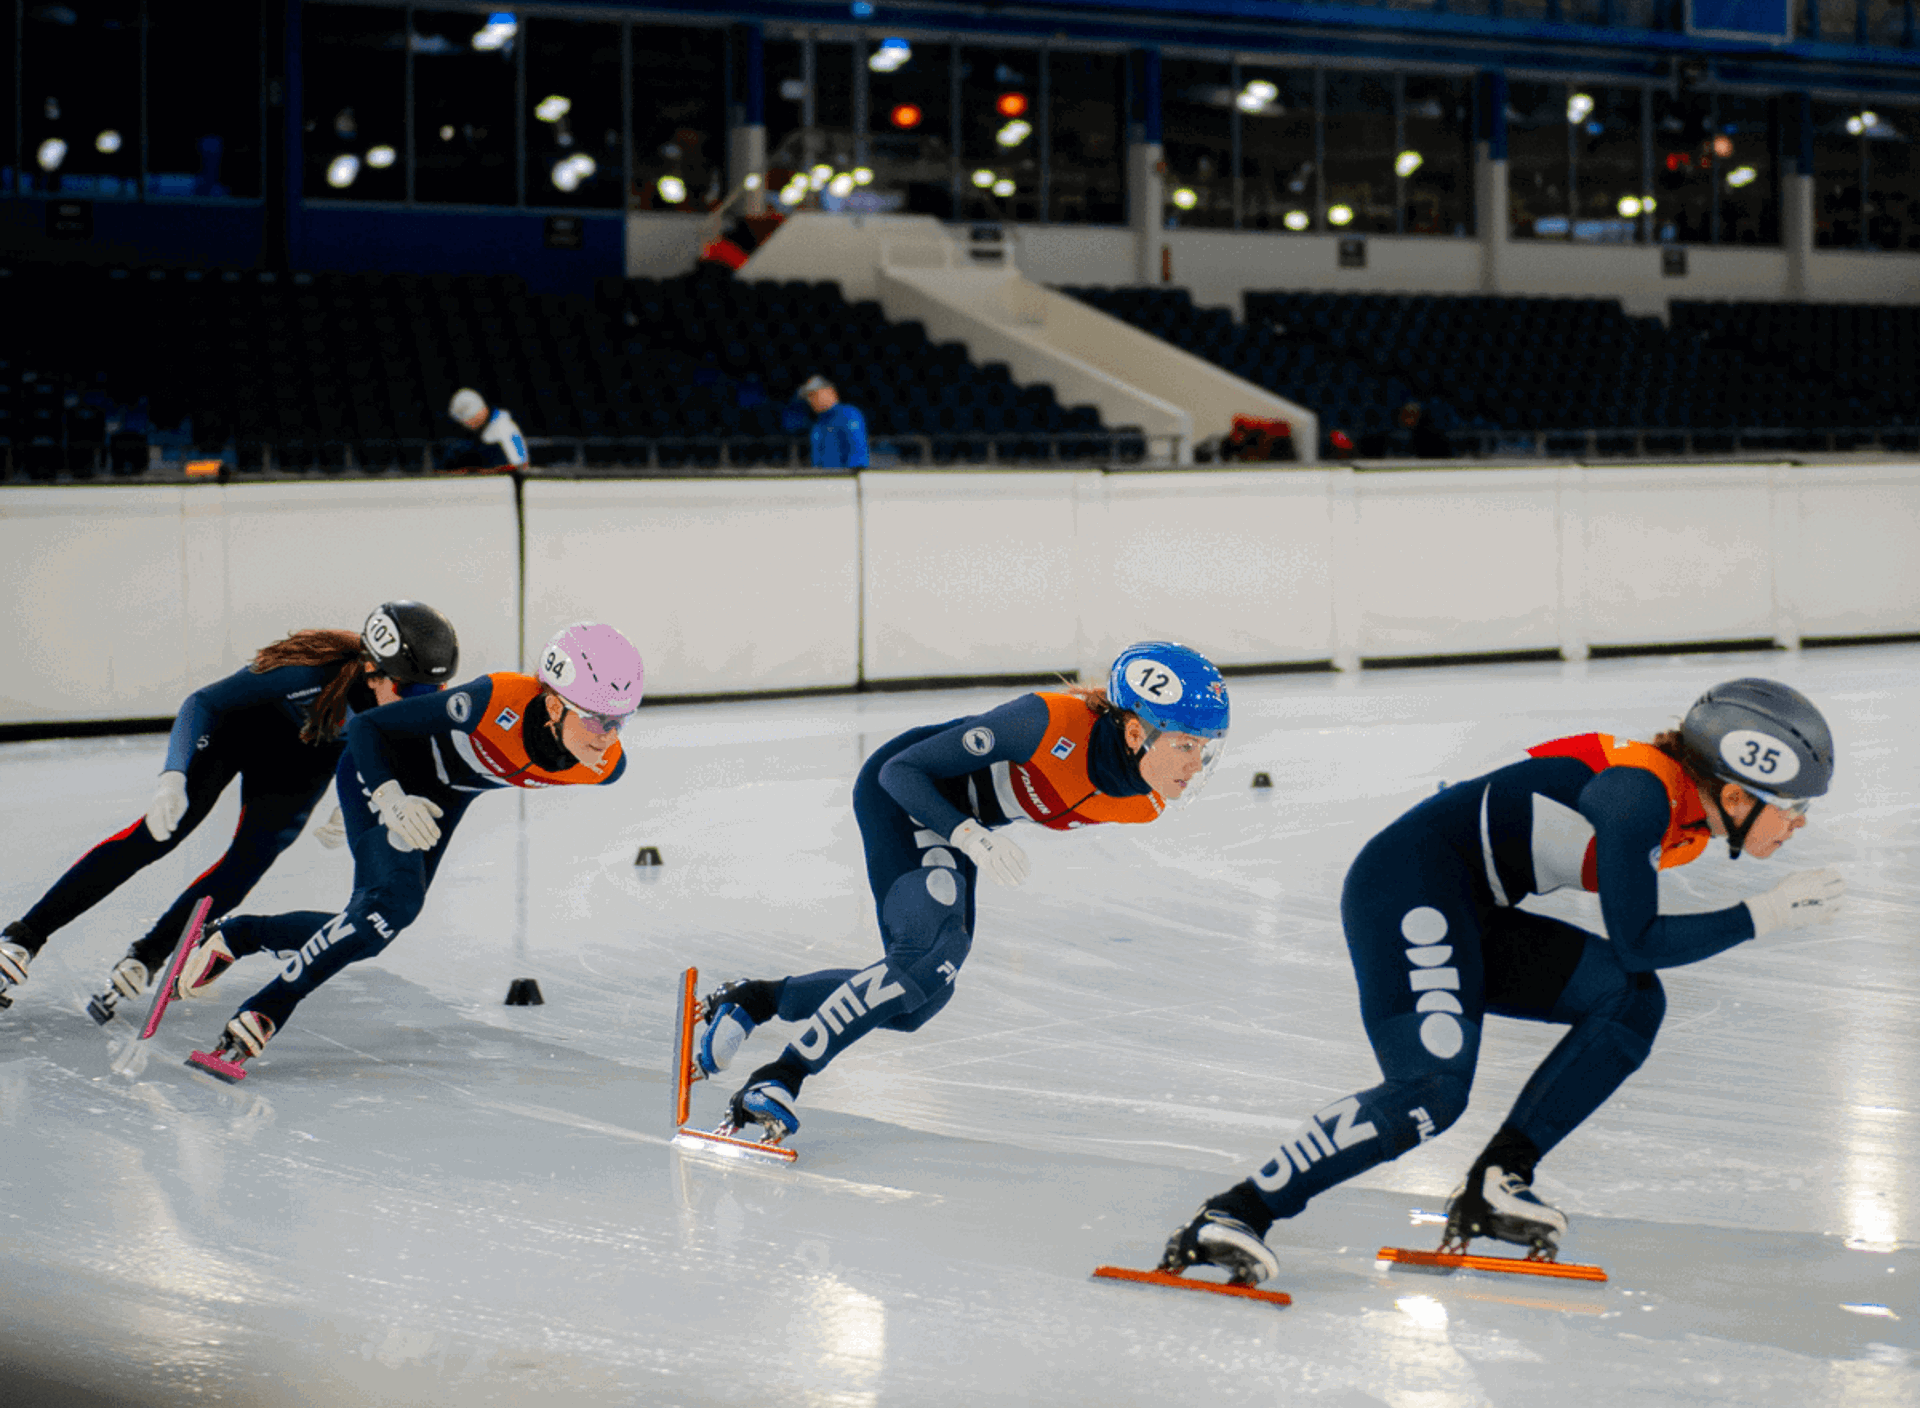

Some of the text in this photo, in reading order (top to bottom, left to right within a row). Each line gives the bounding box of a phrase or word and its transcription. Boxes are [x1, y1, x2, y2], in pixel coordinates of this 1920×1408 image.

[370, 619, 396, 650] 107
[545, 652, 566, 679] 94
[1141, 667, 1170, 697] 12
[1739, 741, 1781, 774] 35
[1021, 775, 1051, 815] DAIKIN
[366, 911, 394, 939] FILA
[790, 963, 906, 1061] NED
[1250, 1096, 1379, 1192] NED
